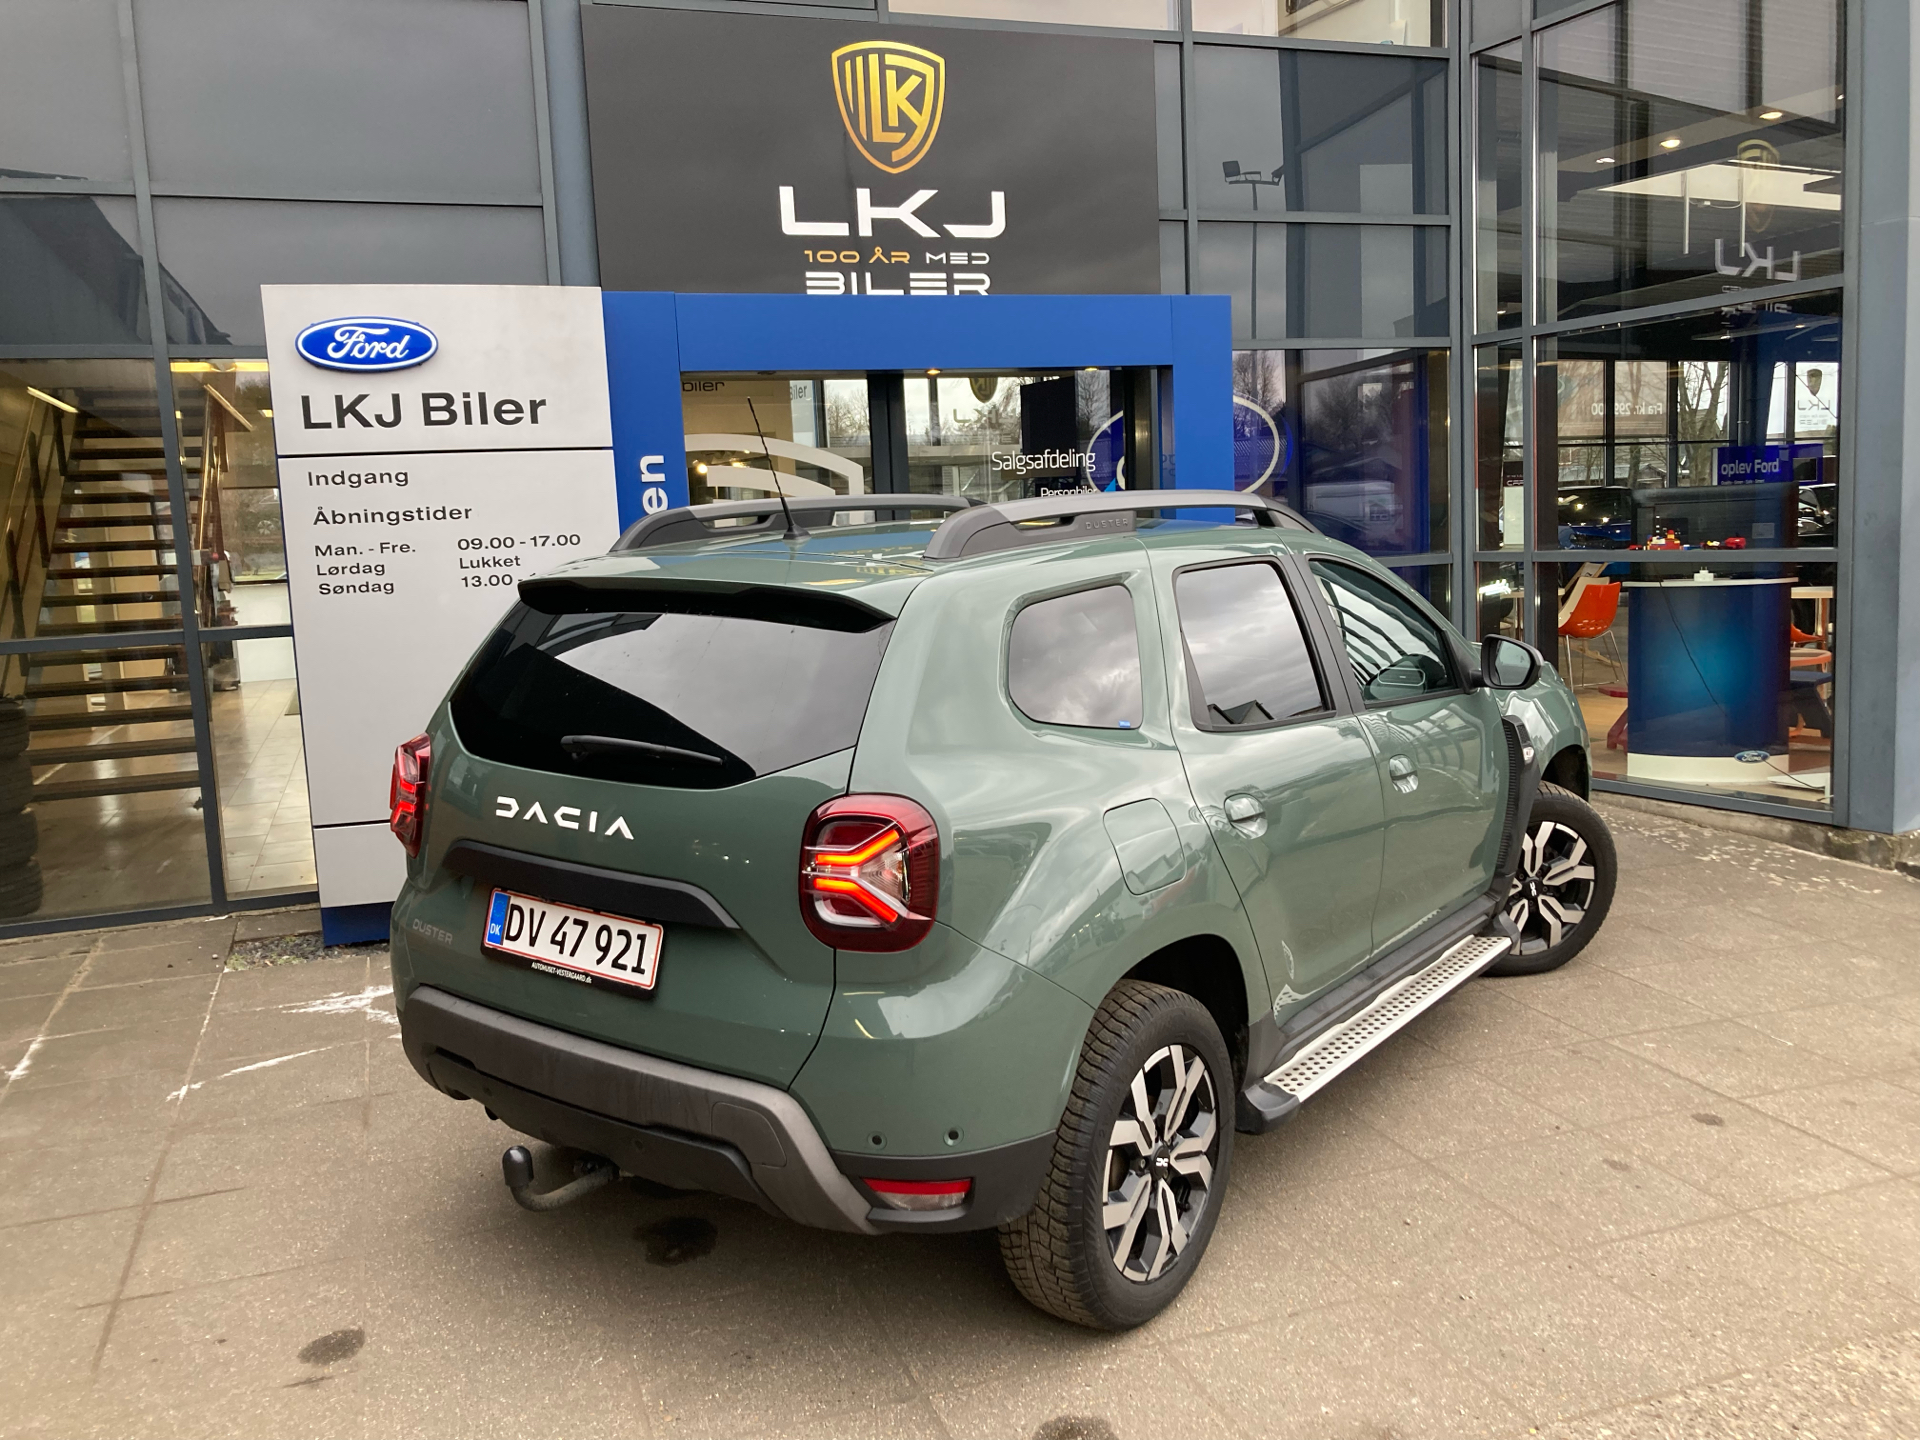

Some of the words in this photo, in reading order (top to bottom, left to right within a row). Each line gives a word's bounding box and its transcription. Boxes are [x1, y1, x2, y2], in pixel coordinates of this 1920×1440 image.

[779, 185, 1006, 239] LKJ
[804, 249, 860, 263] 100
[868, 246, 911, 264] ÅR
[925, 251, 990, 265] MED
[805, 271, 991, 296] BILER
[326, 325, 411, 360] Ford
[301, 393, 402, 430] LKJ
[421, 391, 547, 427] Biler
[992, 449, 1096, 475] Salgsafdeling
[1721, 459, 1752, 477] oplev
[1754, 458, 1780, 473] Ford
[307, 469, 410, 488] Indgang
[313, 506, 473, 527] Åbningstider
[1085, 517, 1129, 531] DUSTER
[314, 544, 363, 557] Man.
[380, 541, 416, 554] Fre.
[457, 536, 515, 551] 09.00
[530, 533, 581, 548] 17.00
[316, 562, 386, 577] Lørdag
[459, 555, 521, 570] Lukket
[318, 581, 395, 596] Søndag
[461, 573, 513, 588] 13.00
[495, 795, 635, 841] DACIA
[413, 917, 454, 945] DUSTER
[490, 922, 502, 936] DK
[505, 903, 547, 948] DV
[550, 915, 589, 958] 47
[595, 925, 648, 975] 921
